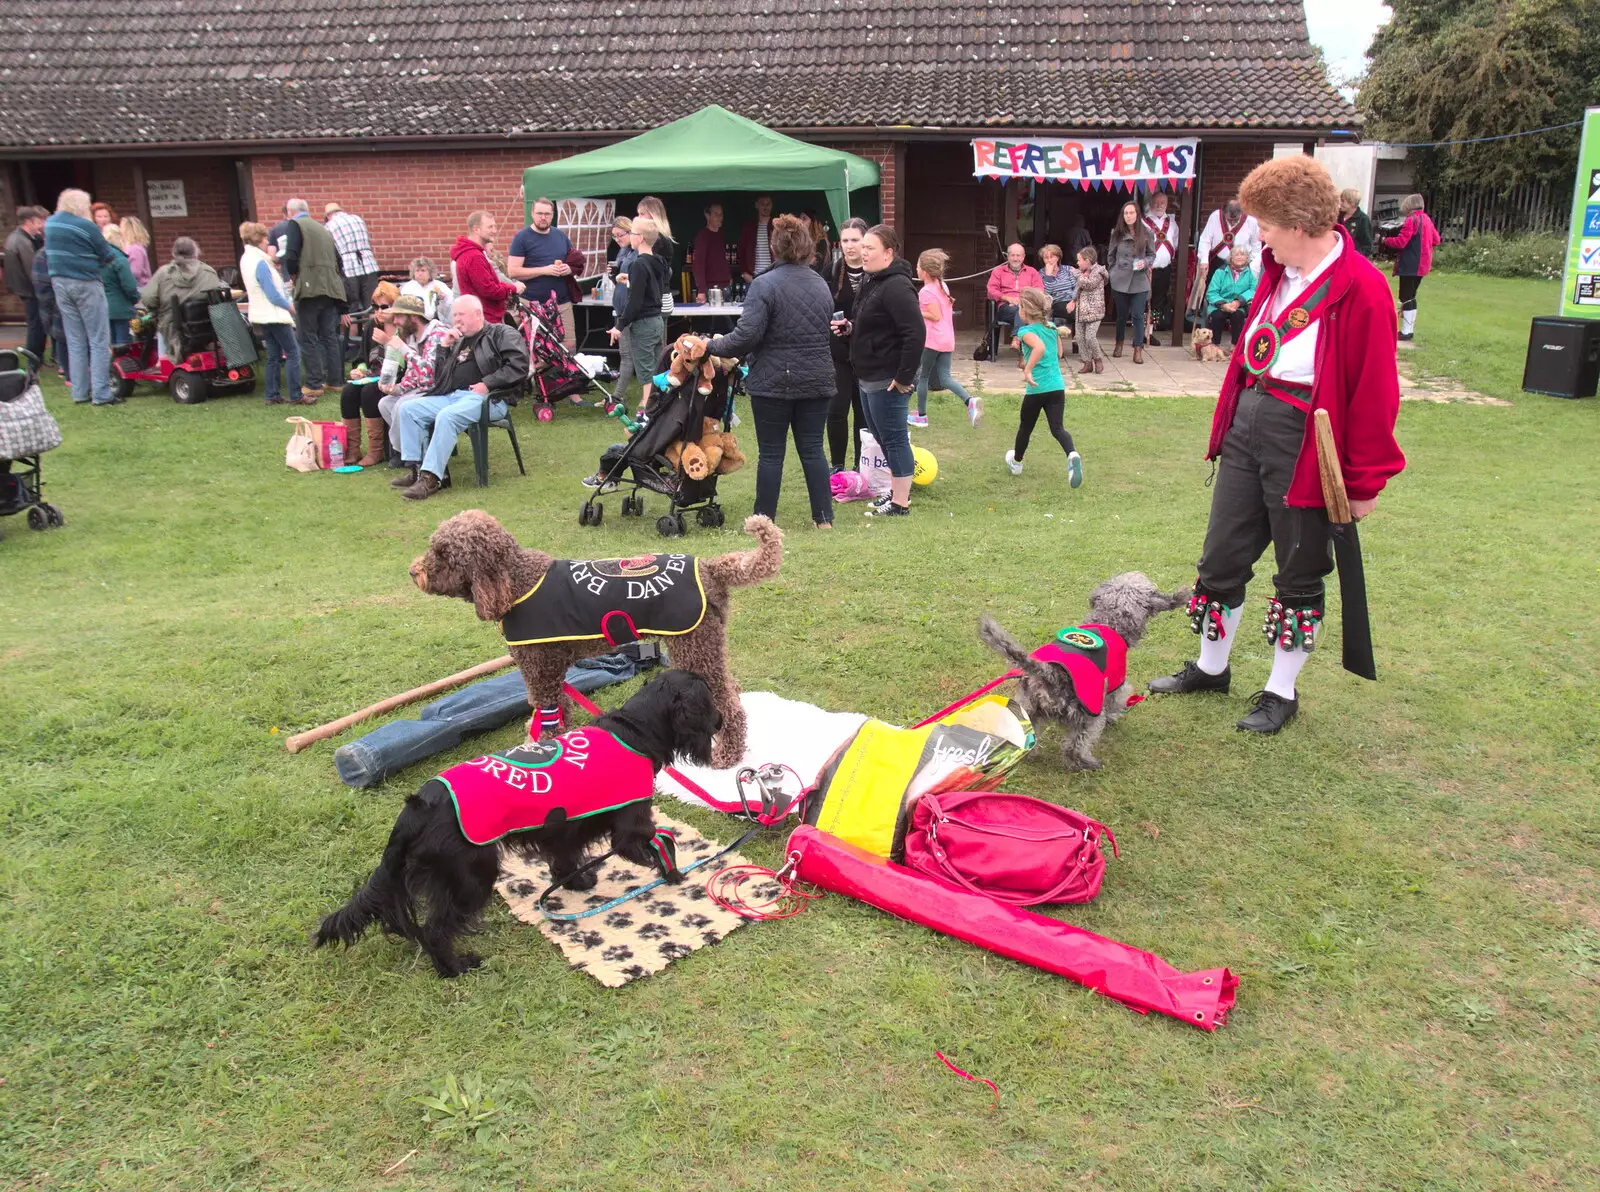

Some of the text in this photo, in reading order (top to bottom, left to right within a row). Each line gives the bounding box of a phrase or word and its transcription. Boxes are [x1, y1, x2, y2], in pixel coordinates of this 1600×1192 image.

[974, 140, 1194, 178] REFRESHMENTS
[569, 560, 609, 596] BRY
[931, 734, 992, 776] fresh
